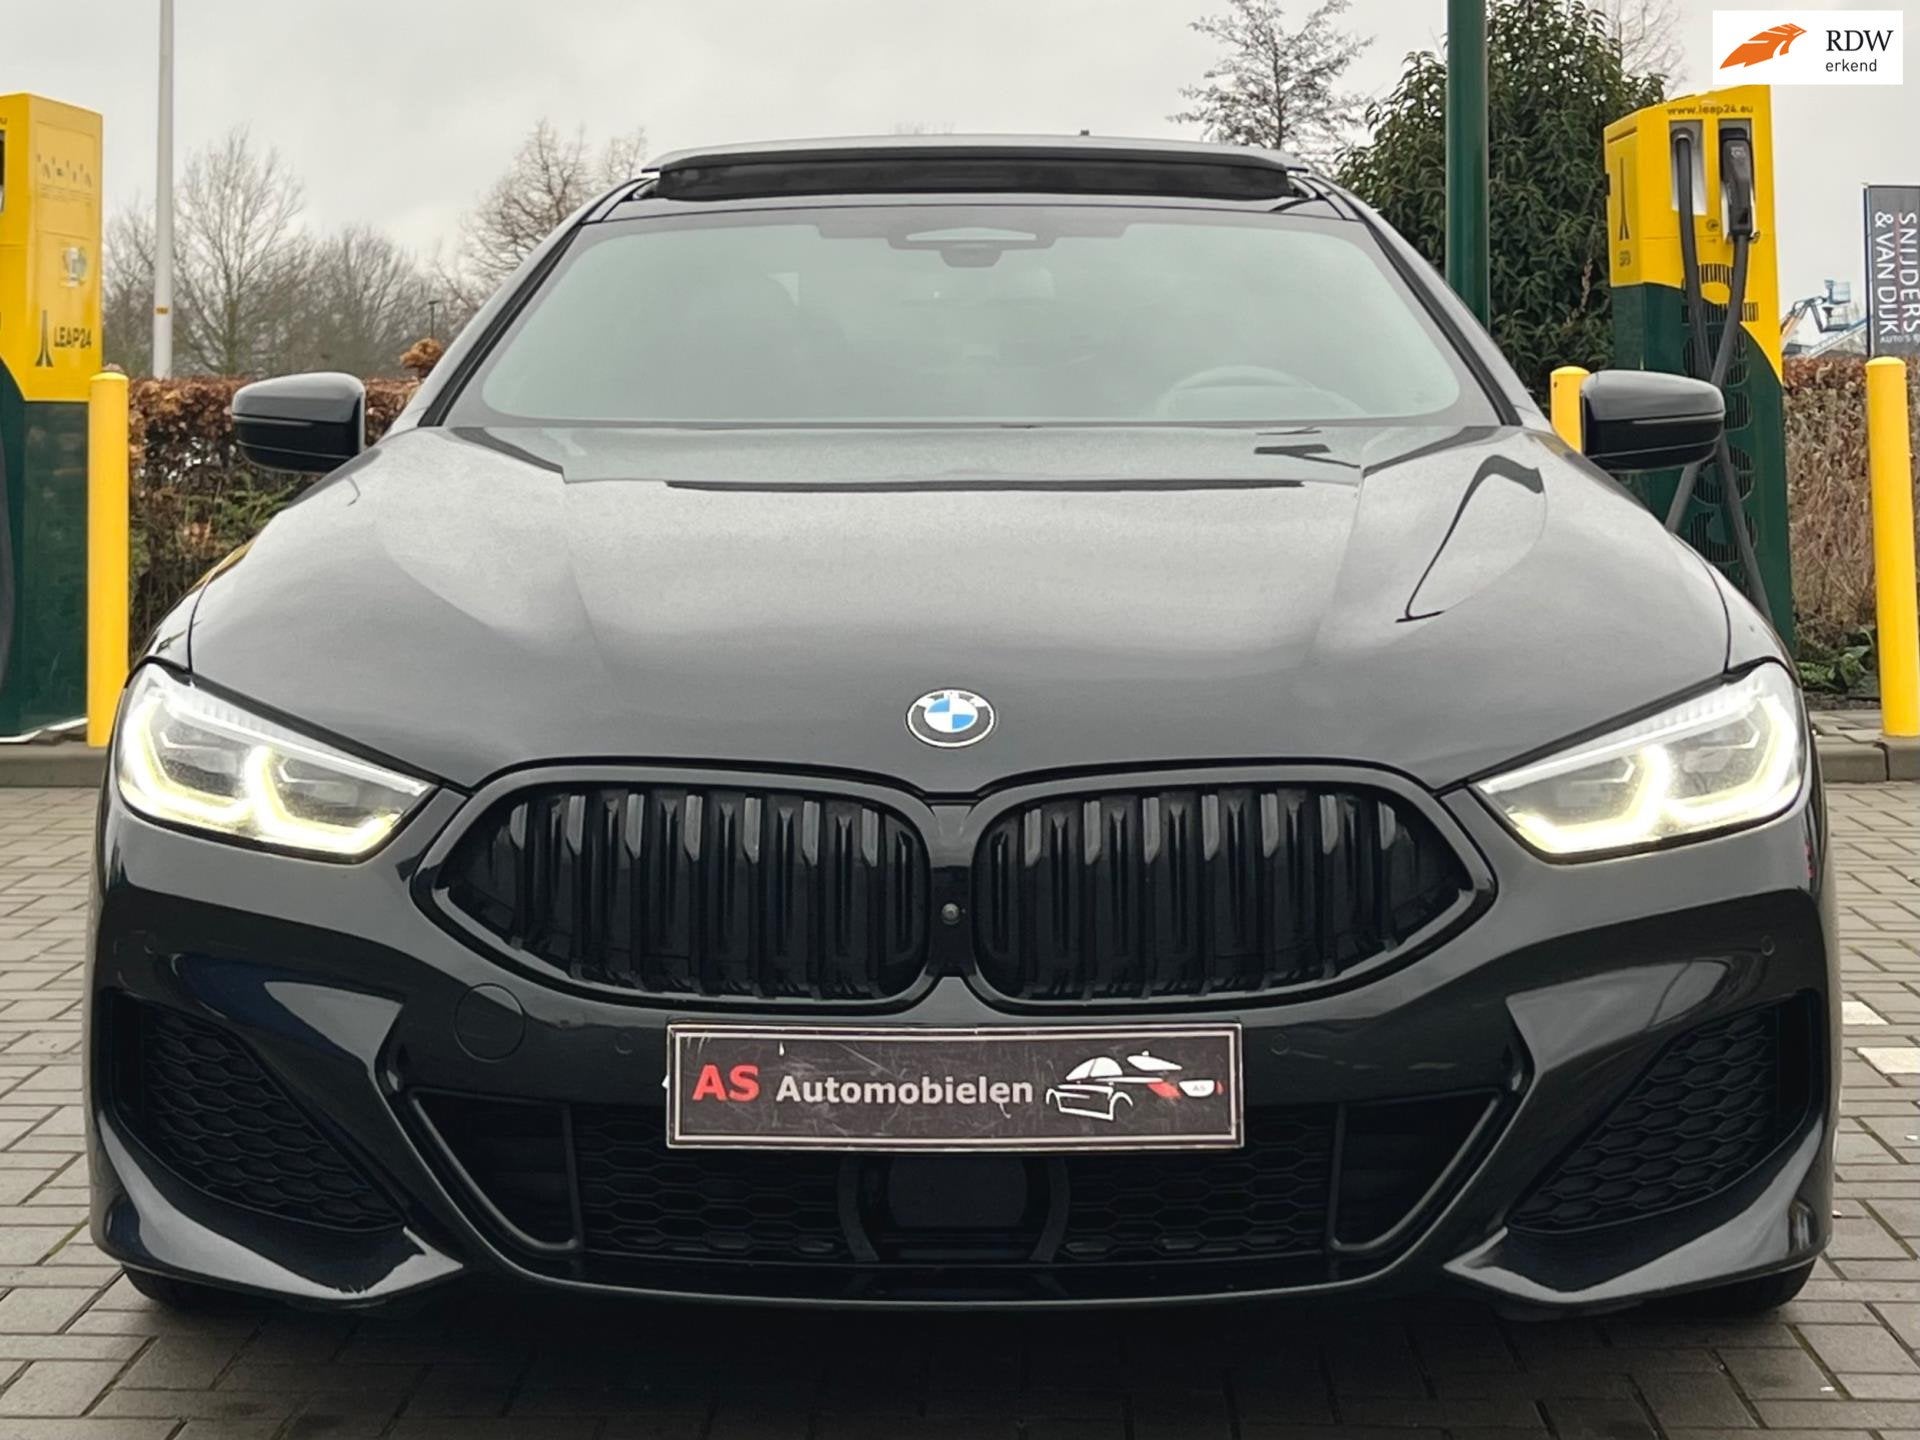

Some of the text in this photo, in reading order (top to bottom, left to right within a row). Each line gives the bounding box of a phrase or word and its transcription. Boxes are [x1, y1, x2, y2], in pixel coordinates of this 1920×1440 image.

[1875, 211, 1900, 334] & VAN DIJK
[1899, 212, 1920, 333] SNIJDERS
[55, 327, 92, 349] LEAP24
[693, 1065, 1033, 1105] AS Automobielen
